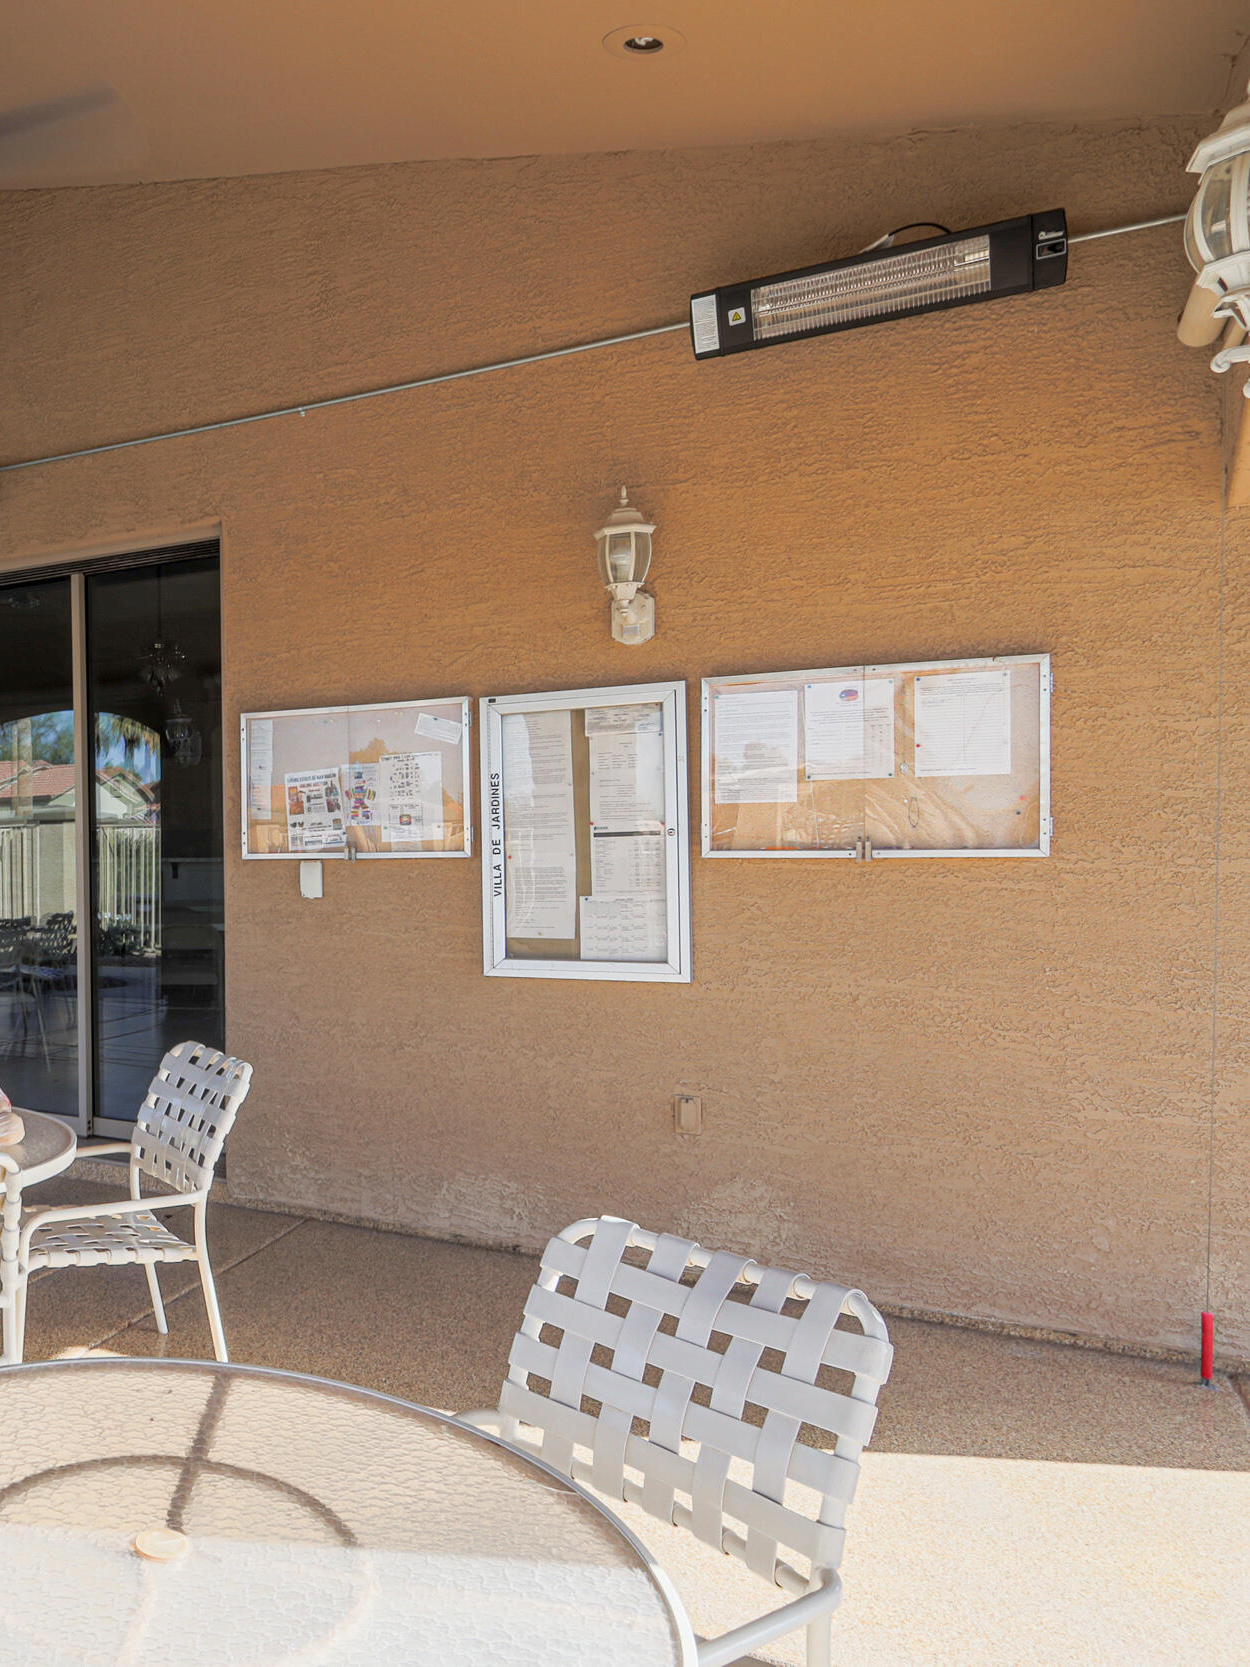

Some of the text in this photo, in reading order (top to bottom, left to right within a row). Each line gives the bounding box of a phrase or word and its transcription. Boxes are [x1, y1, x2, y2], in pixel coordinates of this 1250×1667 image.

[490, 772, 502, 897] VILLA DE JARDINES
